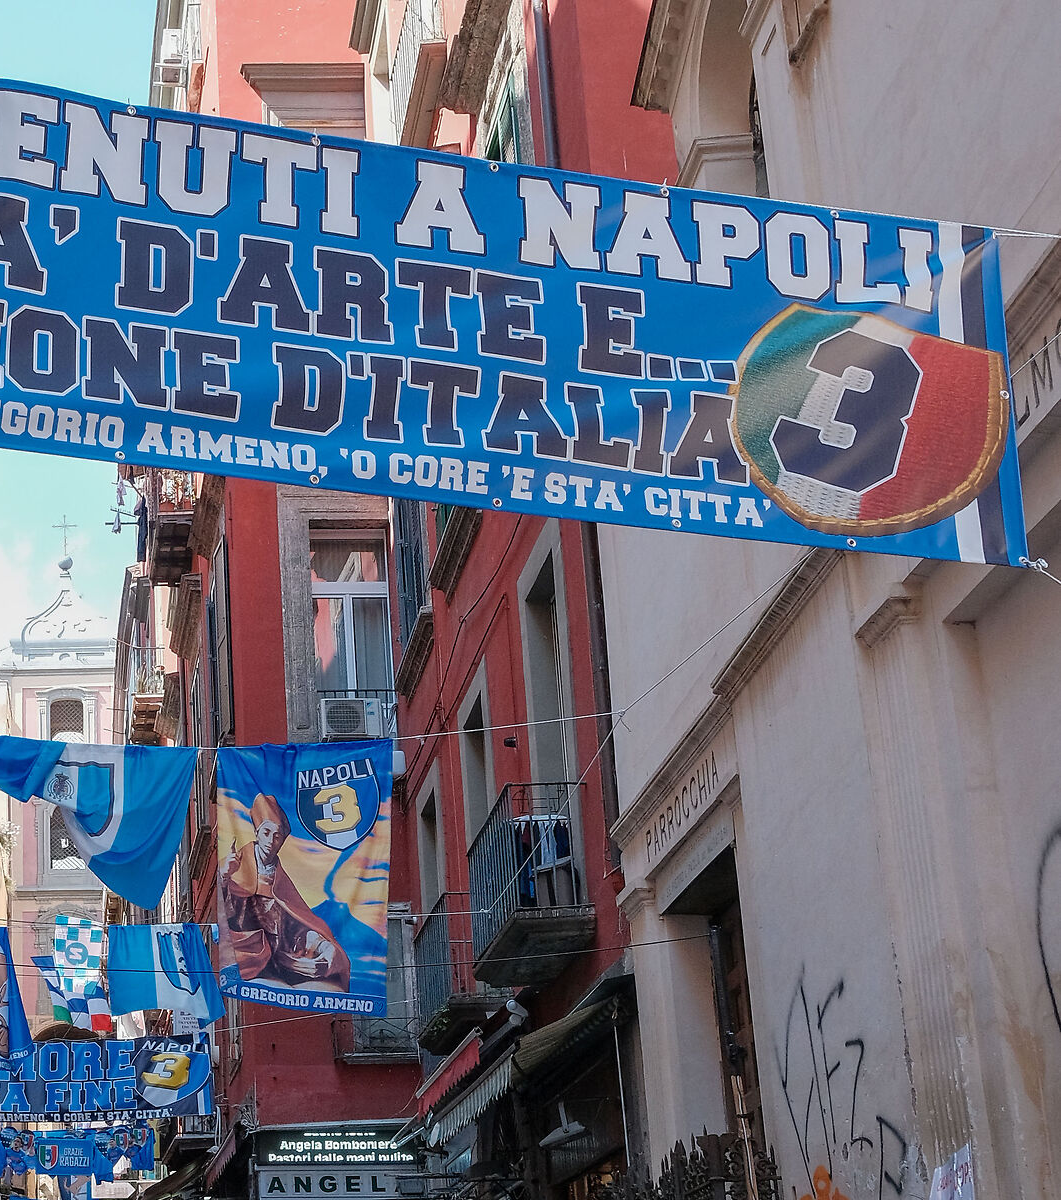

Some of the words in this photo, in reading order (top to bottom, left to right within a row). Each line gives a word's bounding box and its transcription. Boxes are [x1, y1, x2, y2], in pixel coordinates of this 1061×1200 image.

[396, 161, 486, 256] A
[519, 176, 935, 313] NAPOLI
[115, 216, 546, 365] D'ARTE
[272, 342, 750, 487] D'ITALIA
[769, 327, 923, 494] 3
[138, 422, 329, 478] ARMENO,
[389, 455, 489, 496] CORE
[545, 475, 632, 513] STA'
[644, 486, 772, 528] CITTA'
[298, 758, 374, 789] NAPOLI
[313, 785, 362, 834] 3
[646, 751, 719, 863] PARROCCHIA
[240, 986, 309, 1008] GREGORIO
[312, 997, 374, 1013] ARMENO
[142, 1039, 208, 1054] NAPOLI
[142, 1053, 191, 1090] 3
[45, 1079, 137, 1113] FINE
[64, 1112, 91, 1122] CORE
[59, 1156, 89, 1167] RAGAZZI
[63, 1147, 84, 1156] GRAZIE
[280, 1140, 322, 1152] Angela
[267, 1175, 399, 1193] ANGEL
